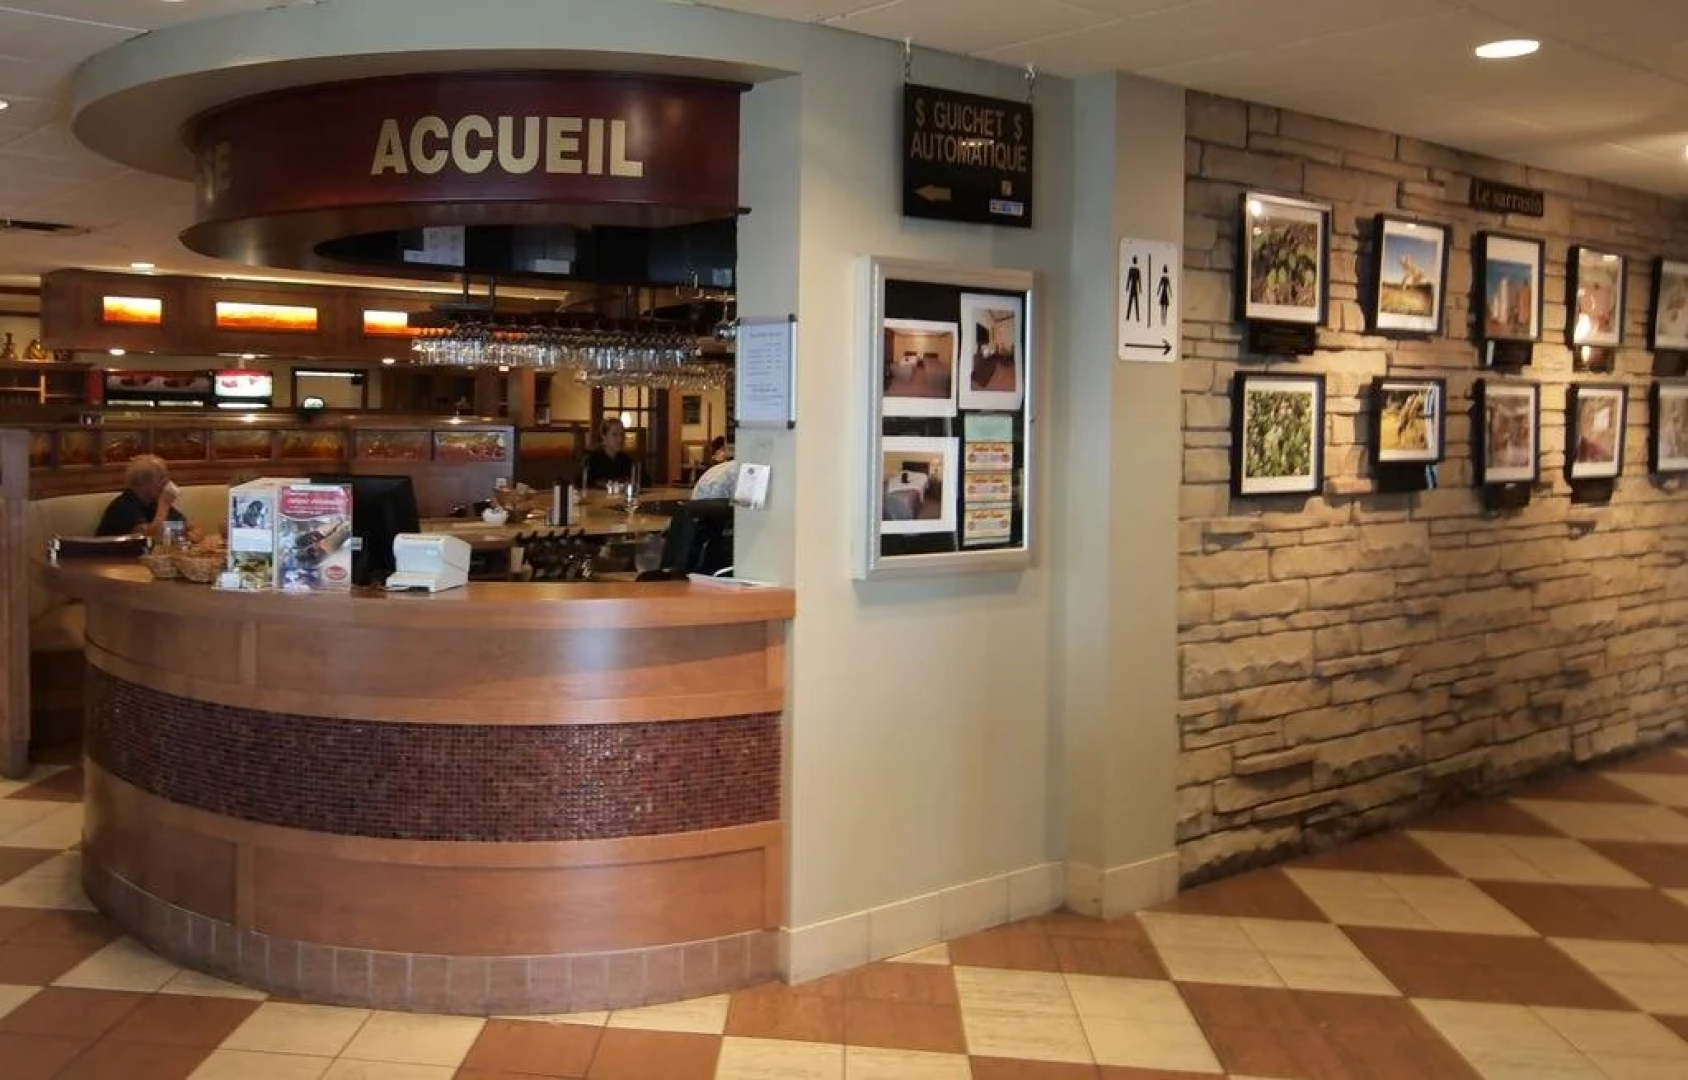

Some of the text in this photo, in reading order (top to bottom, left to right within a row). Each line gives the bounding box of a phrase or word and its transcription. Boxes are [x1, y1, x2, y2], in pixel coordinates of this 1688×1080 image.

[915, 97, 926, 129] $
[934, 101, 1005, 136] GUICHET
[370, 114, 644, 178] ACCUEIL
[910, 132, 1028, 172] AUTOMATIQUE
[1475, 182, 1492, 203] Le
